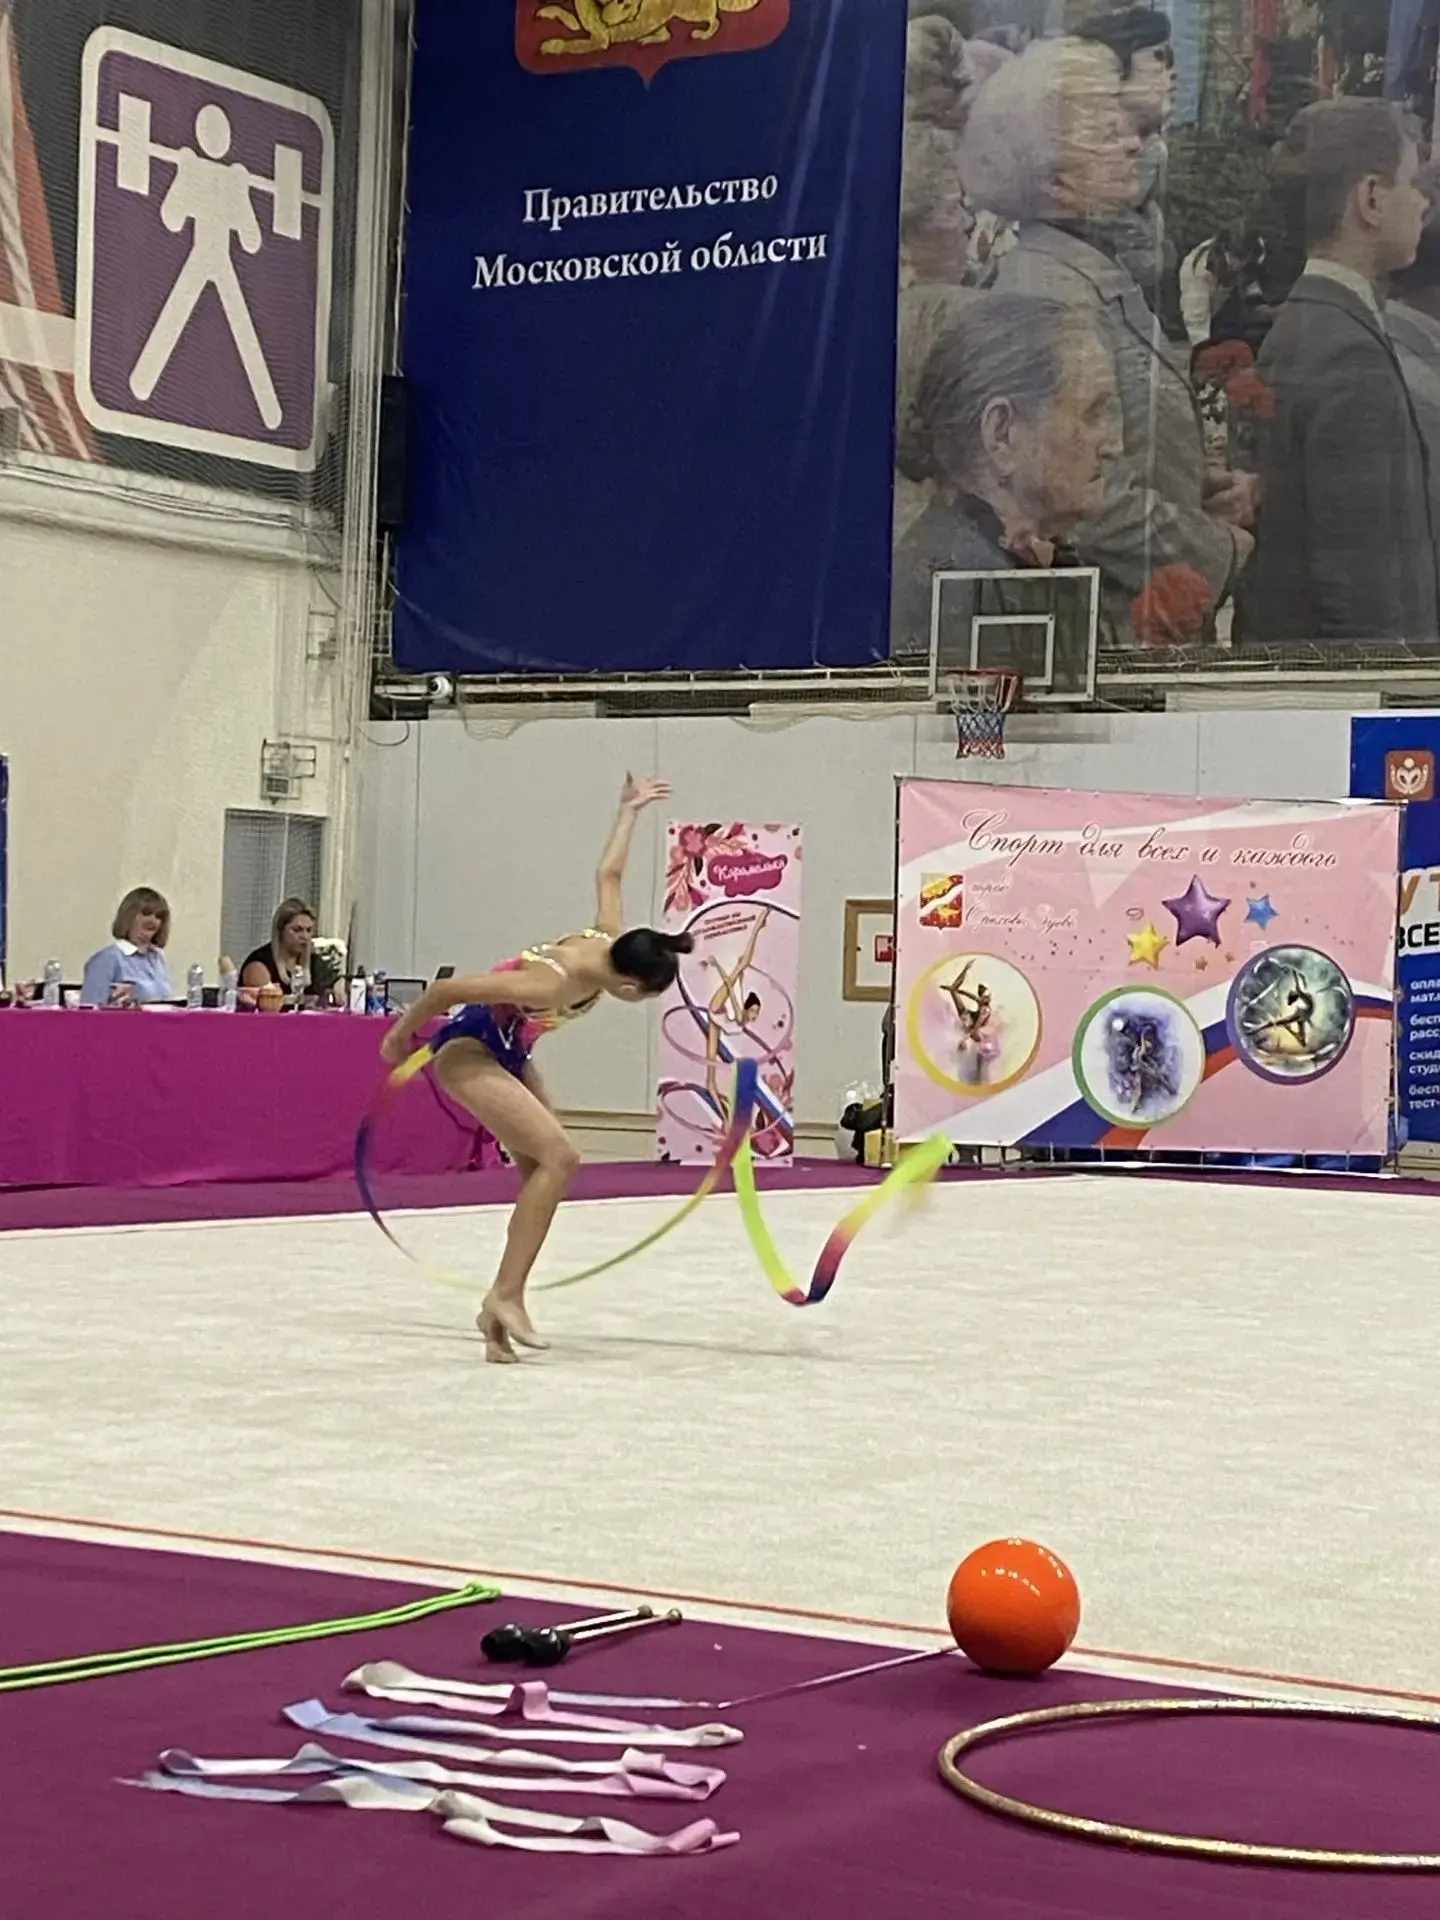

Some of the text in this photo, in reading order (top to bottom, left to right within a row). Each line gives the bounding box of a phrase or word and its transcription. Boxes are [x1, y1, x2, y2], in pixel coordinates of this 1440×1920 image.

[522, 173, 779, 231] Правительство
[471, 231, 828, 290] Московской области
[962, 810, 1337, 867] Спорт для всех и каждого
